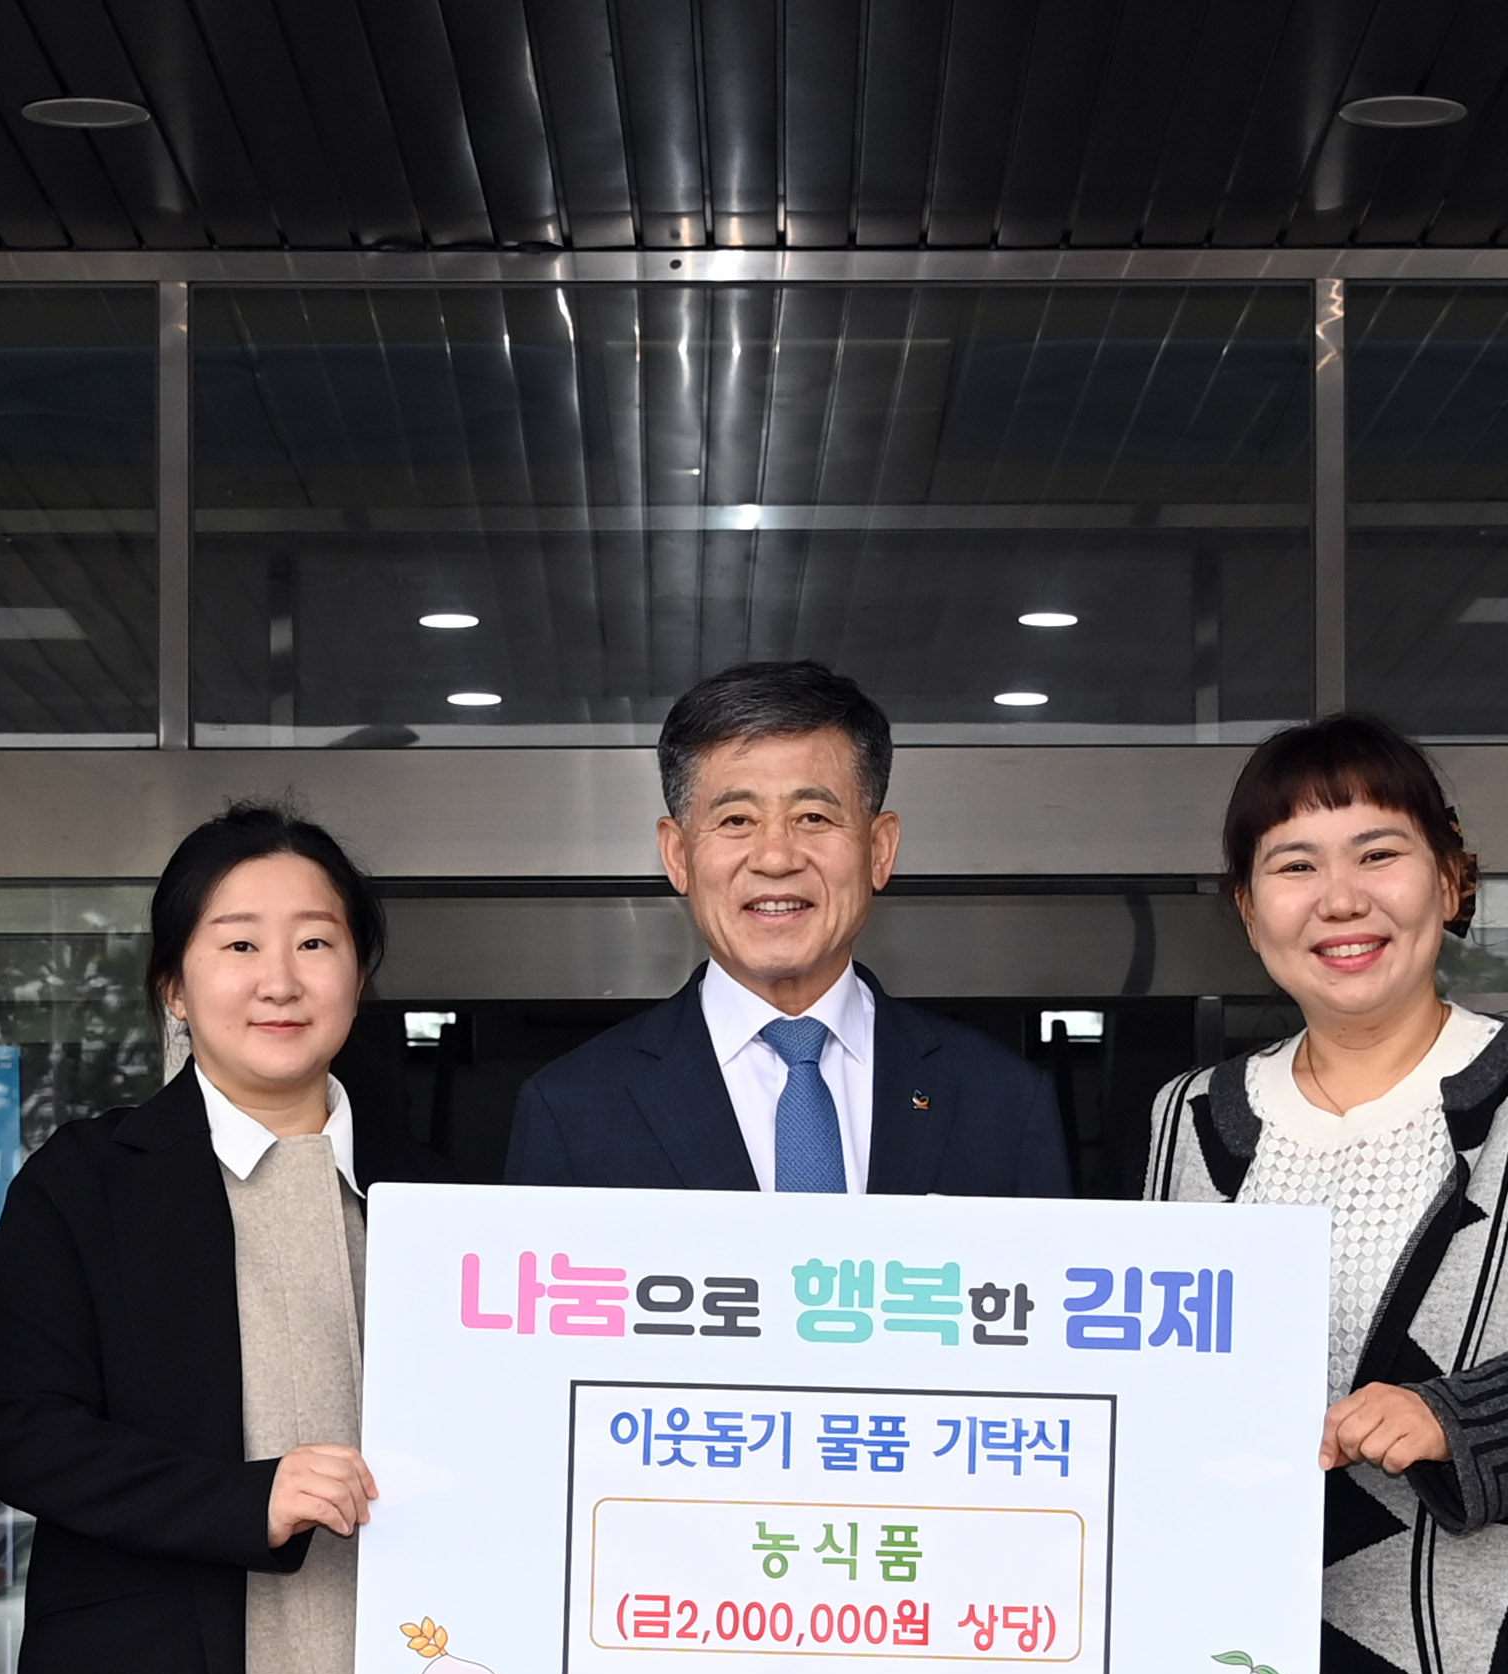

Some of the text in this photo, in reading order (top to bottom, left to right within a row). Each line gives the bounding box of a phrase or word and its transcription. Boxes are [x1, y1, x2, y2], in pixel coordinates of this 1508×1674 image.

[461, 1251, 1234, 1354] 나눔으로 행복한 김제
[609, 1406, 1071, 1478] 이웃돕기 물품 기탁식
[614, 1592, 1057, 1653] (금2,000,000원 상당)
